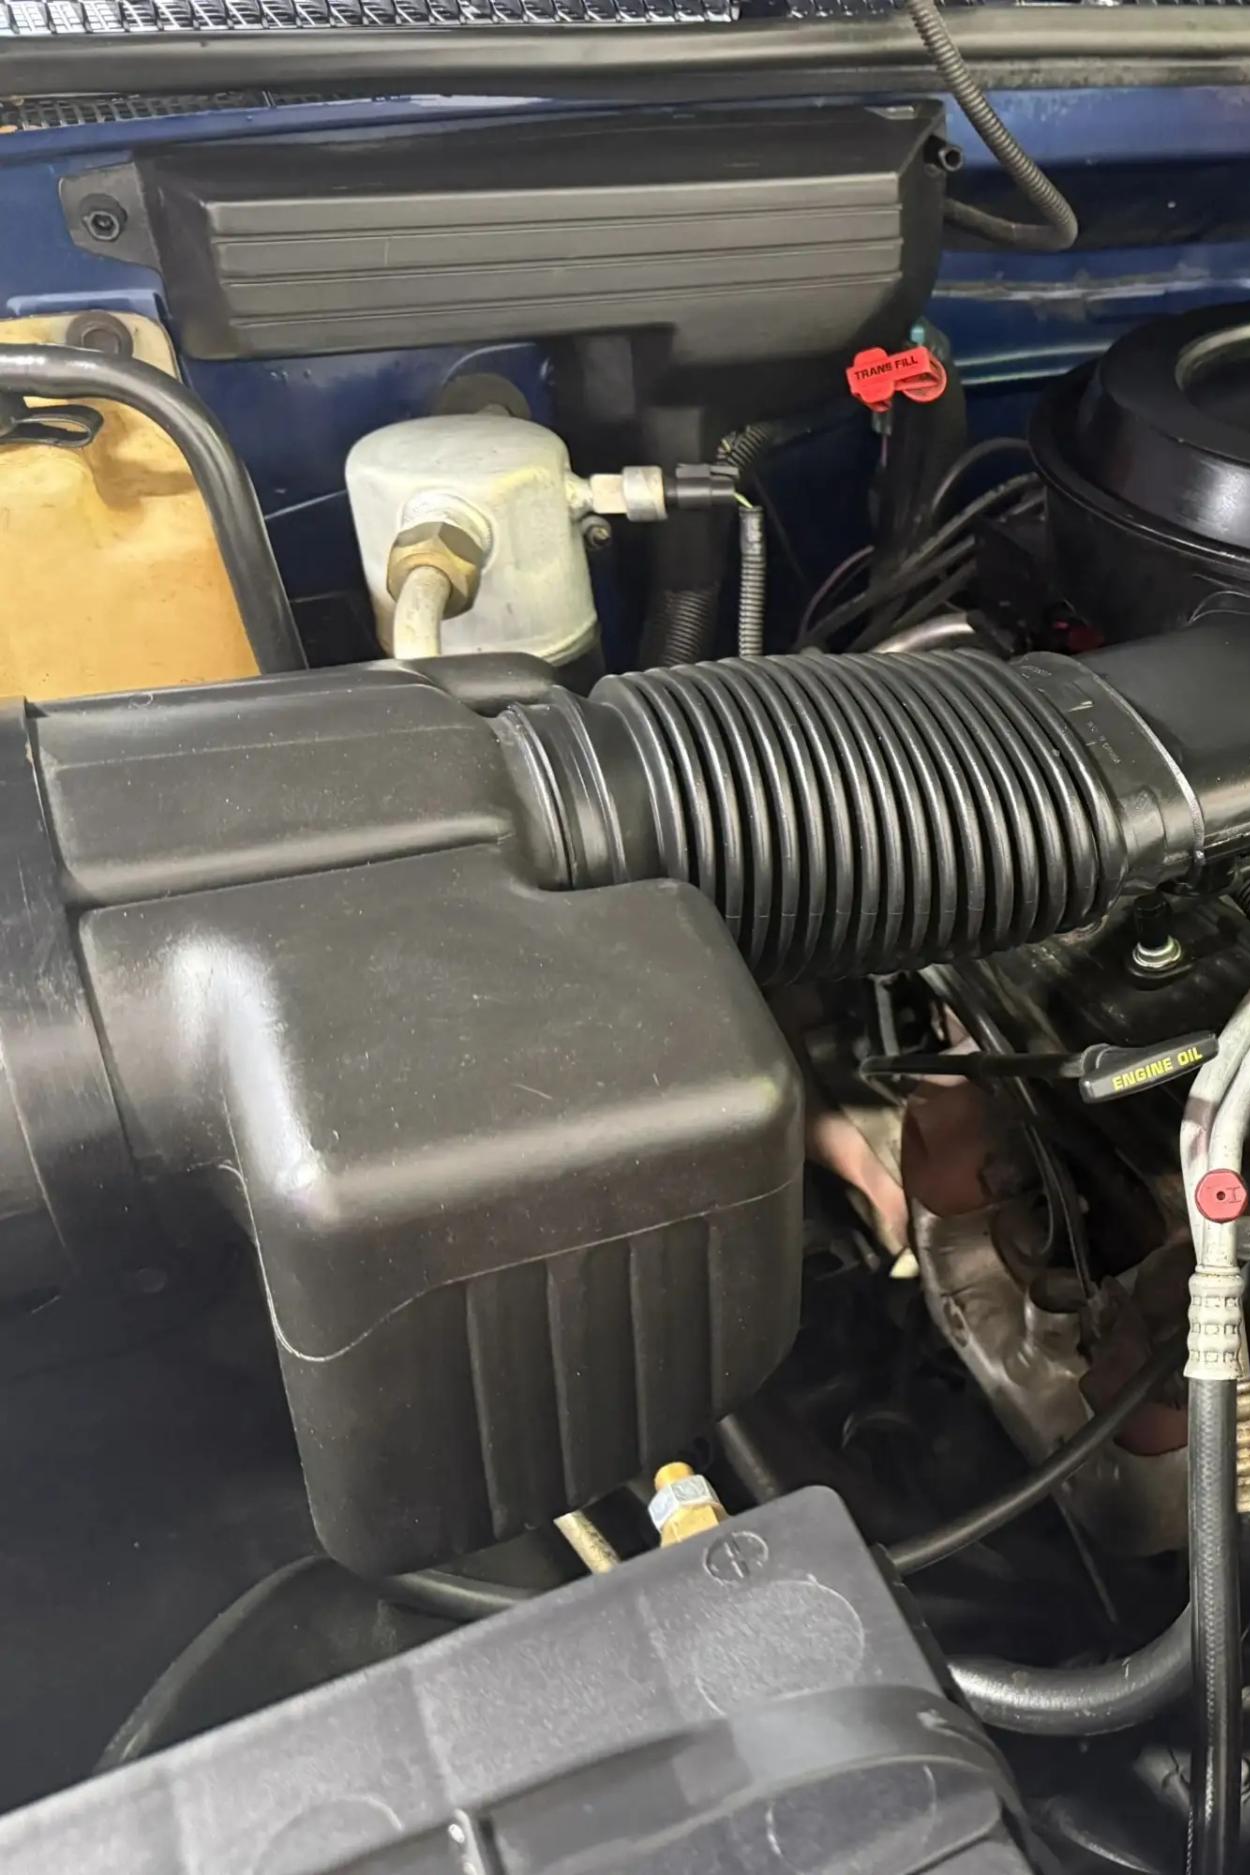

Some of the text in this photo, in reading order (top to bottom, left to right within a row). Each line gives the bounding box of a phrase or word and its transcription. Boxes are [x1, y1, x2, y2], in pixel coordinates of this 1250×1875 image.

[854, 355, 919, 381] TRANS FILL
[1112, 1046, 1203, 1091] ENGINE OIL
